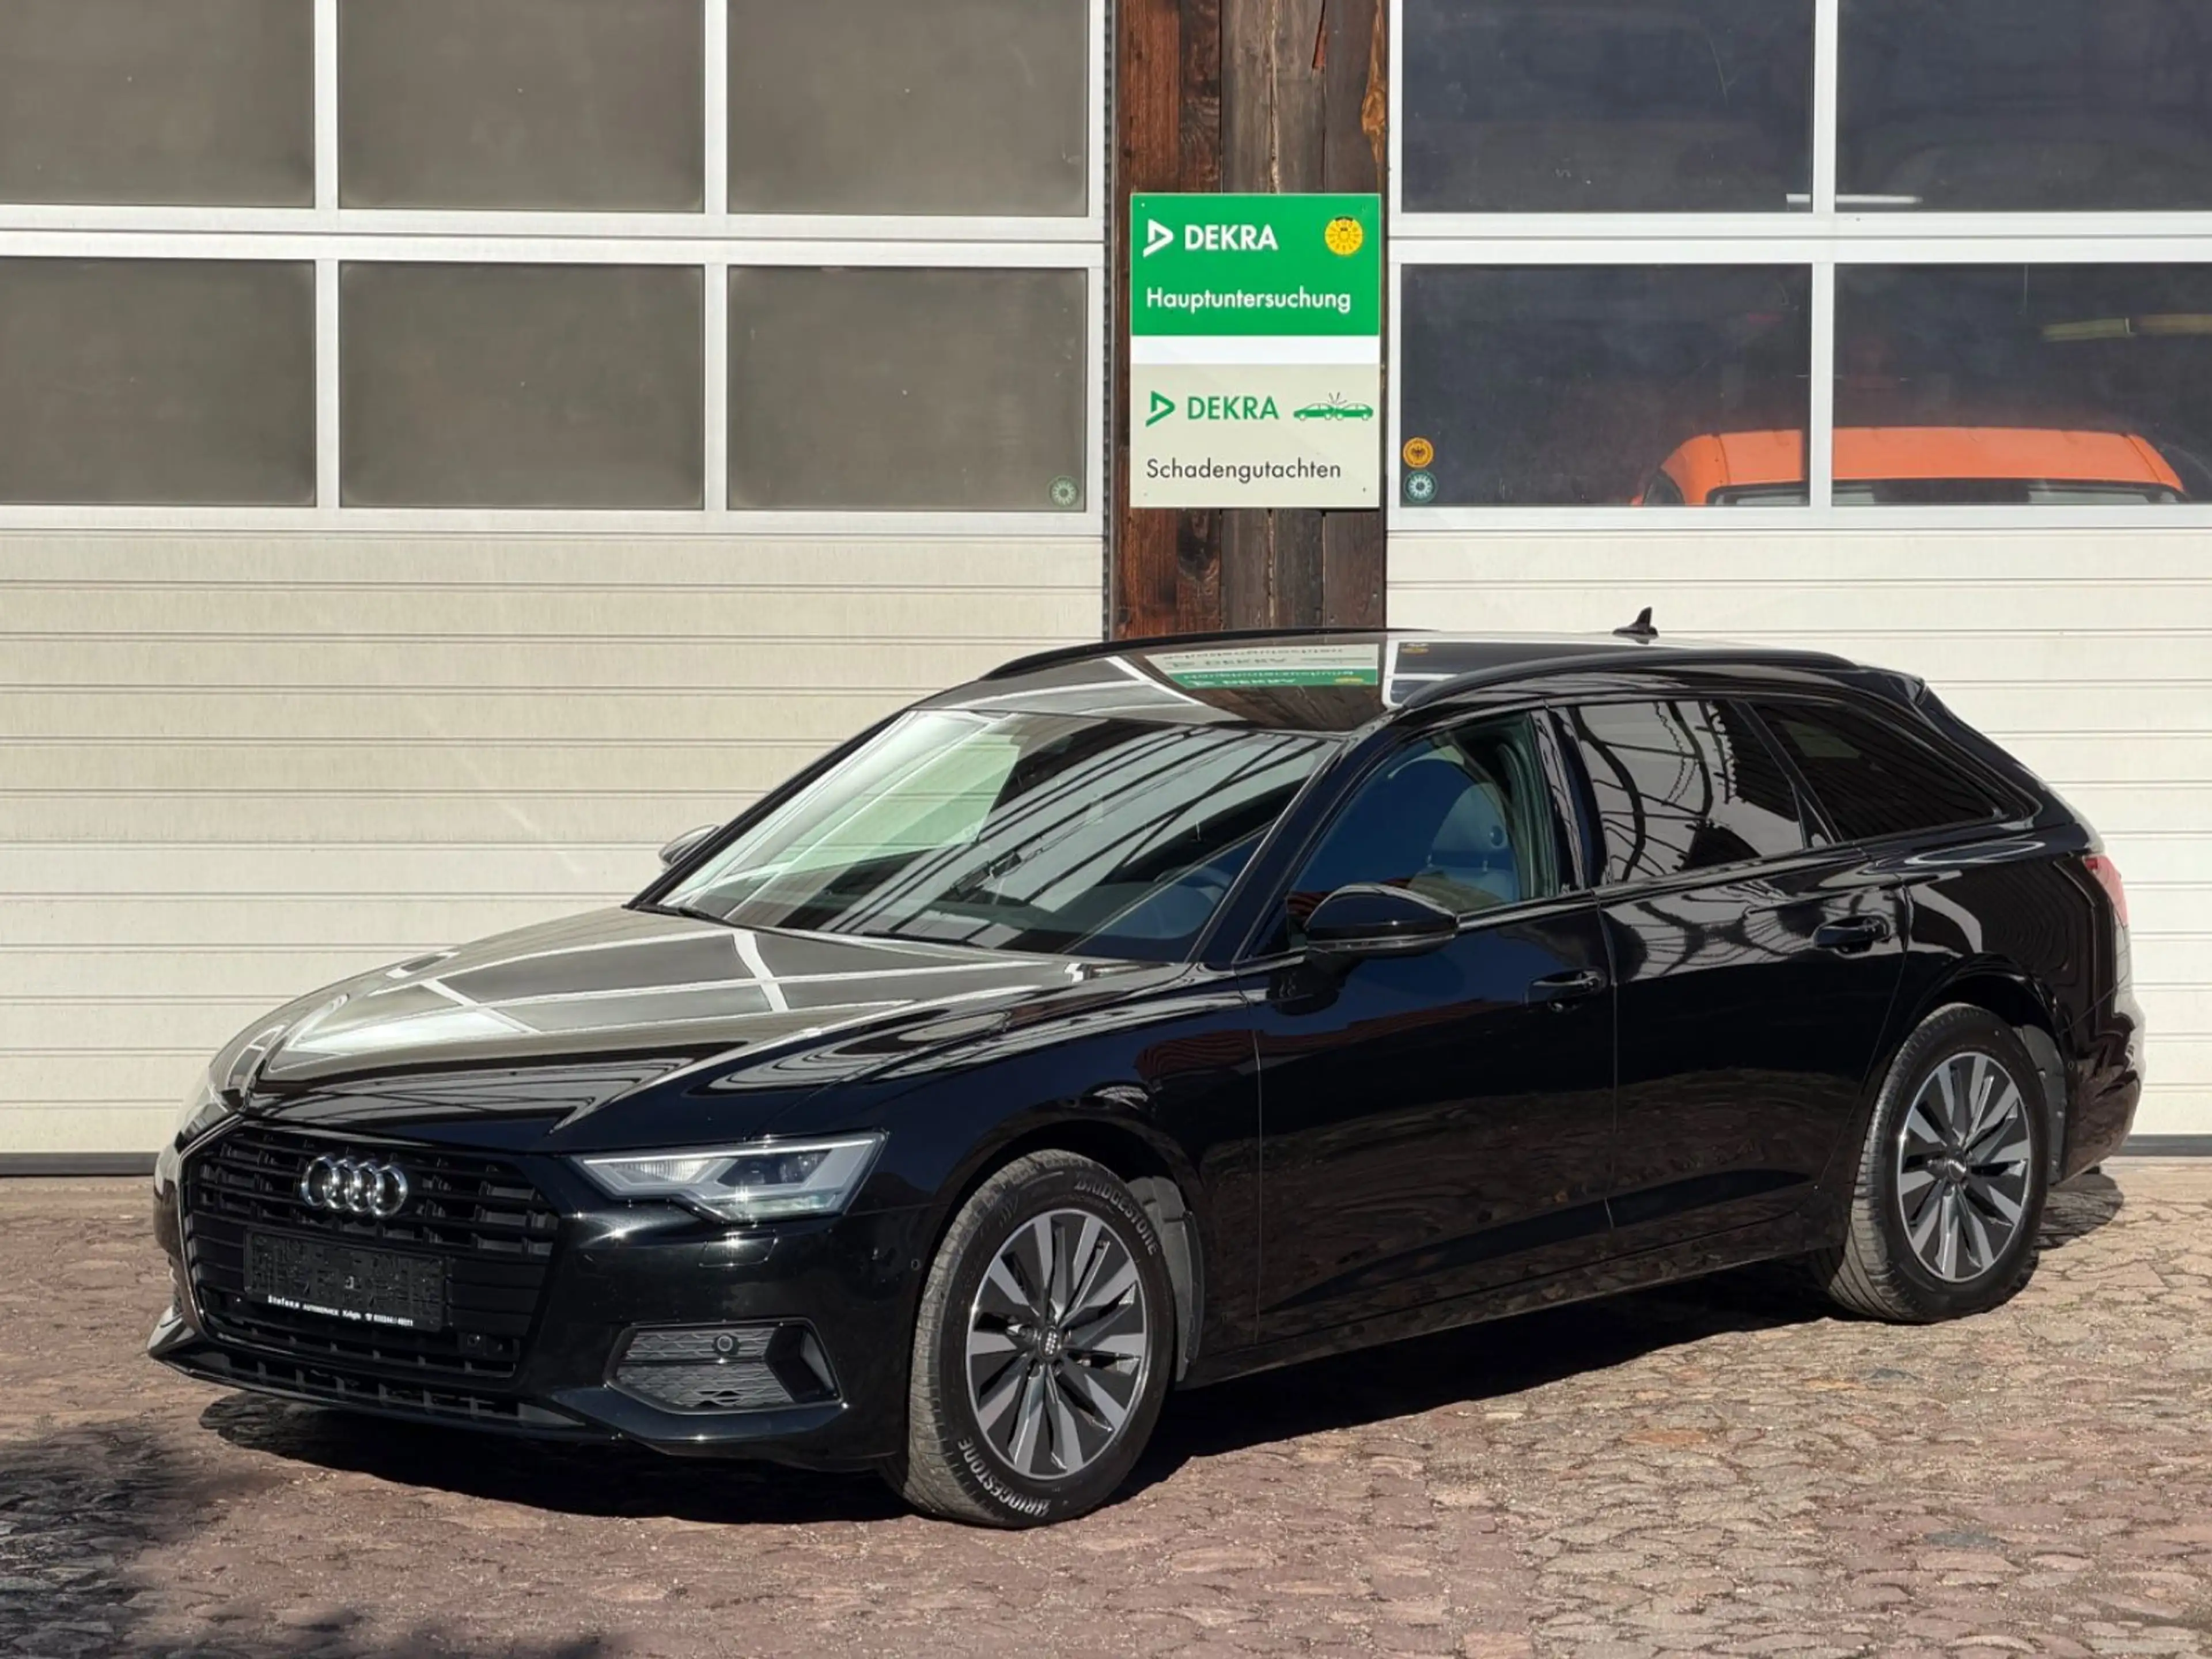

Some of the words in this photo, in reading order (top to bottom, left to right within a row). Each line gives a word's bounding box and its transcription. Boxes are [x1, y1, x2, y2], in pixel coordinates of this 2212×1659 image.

[1185, 224, 1278, 250] DEKRA
[1146, 287, 1351, 313] Hauptuntersuchung
[1187, 396, 1279, 420] DEKRA
[1146, 459, 1341, 483] Schadengutachten
